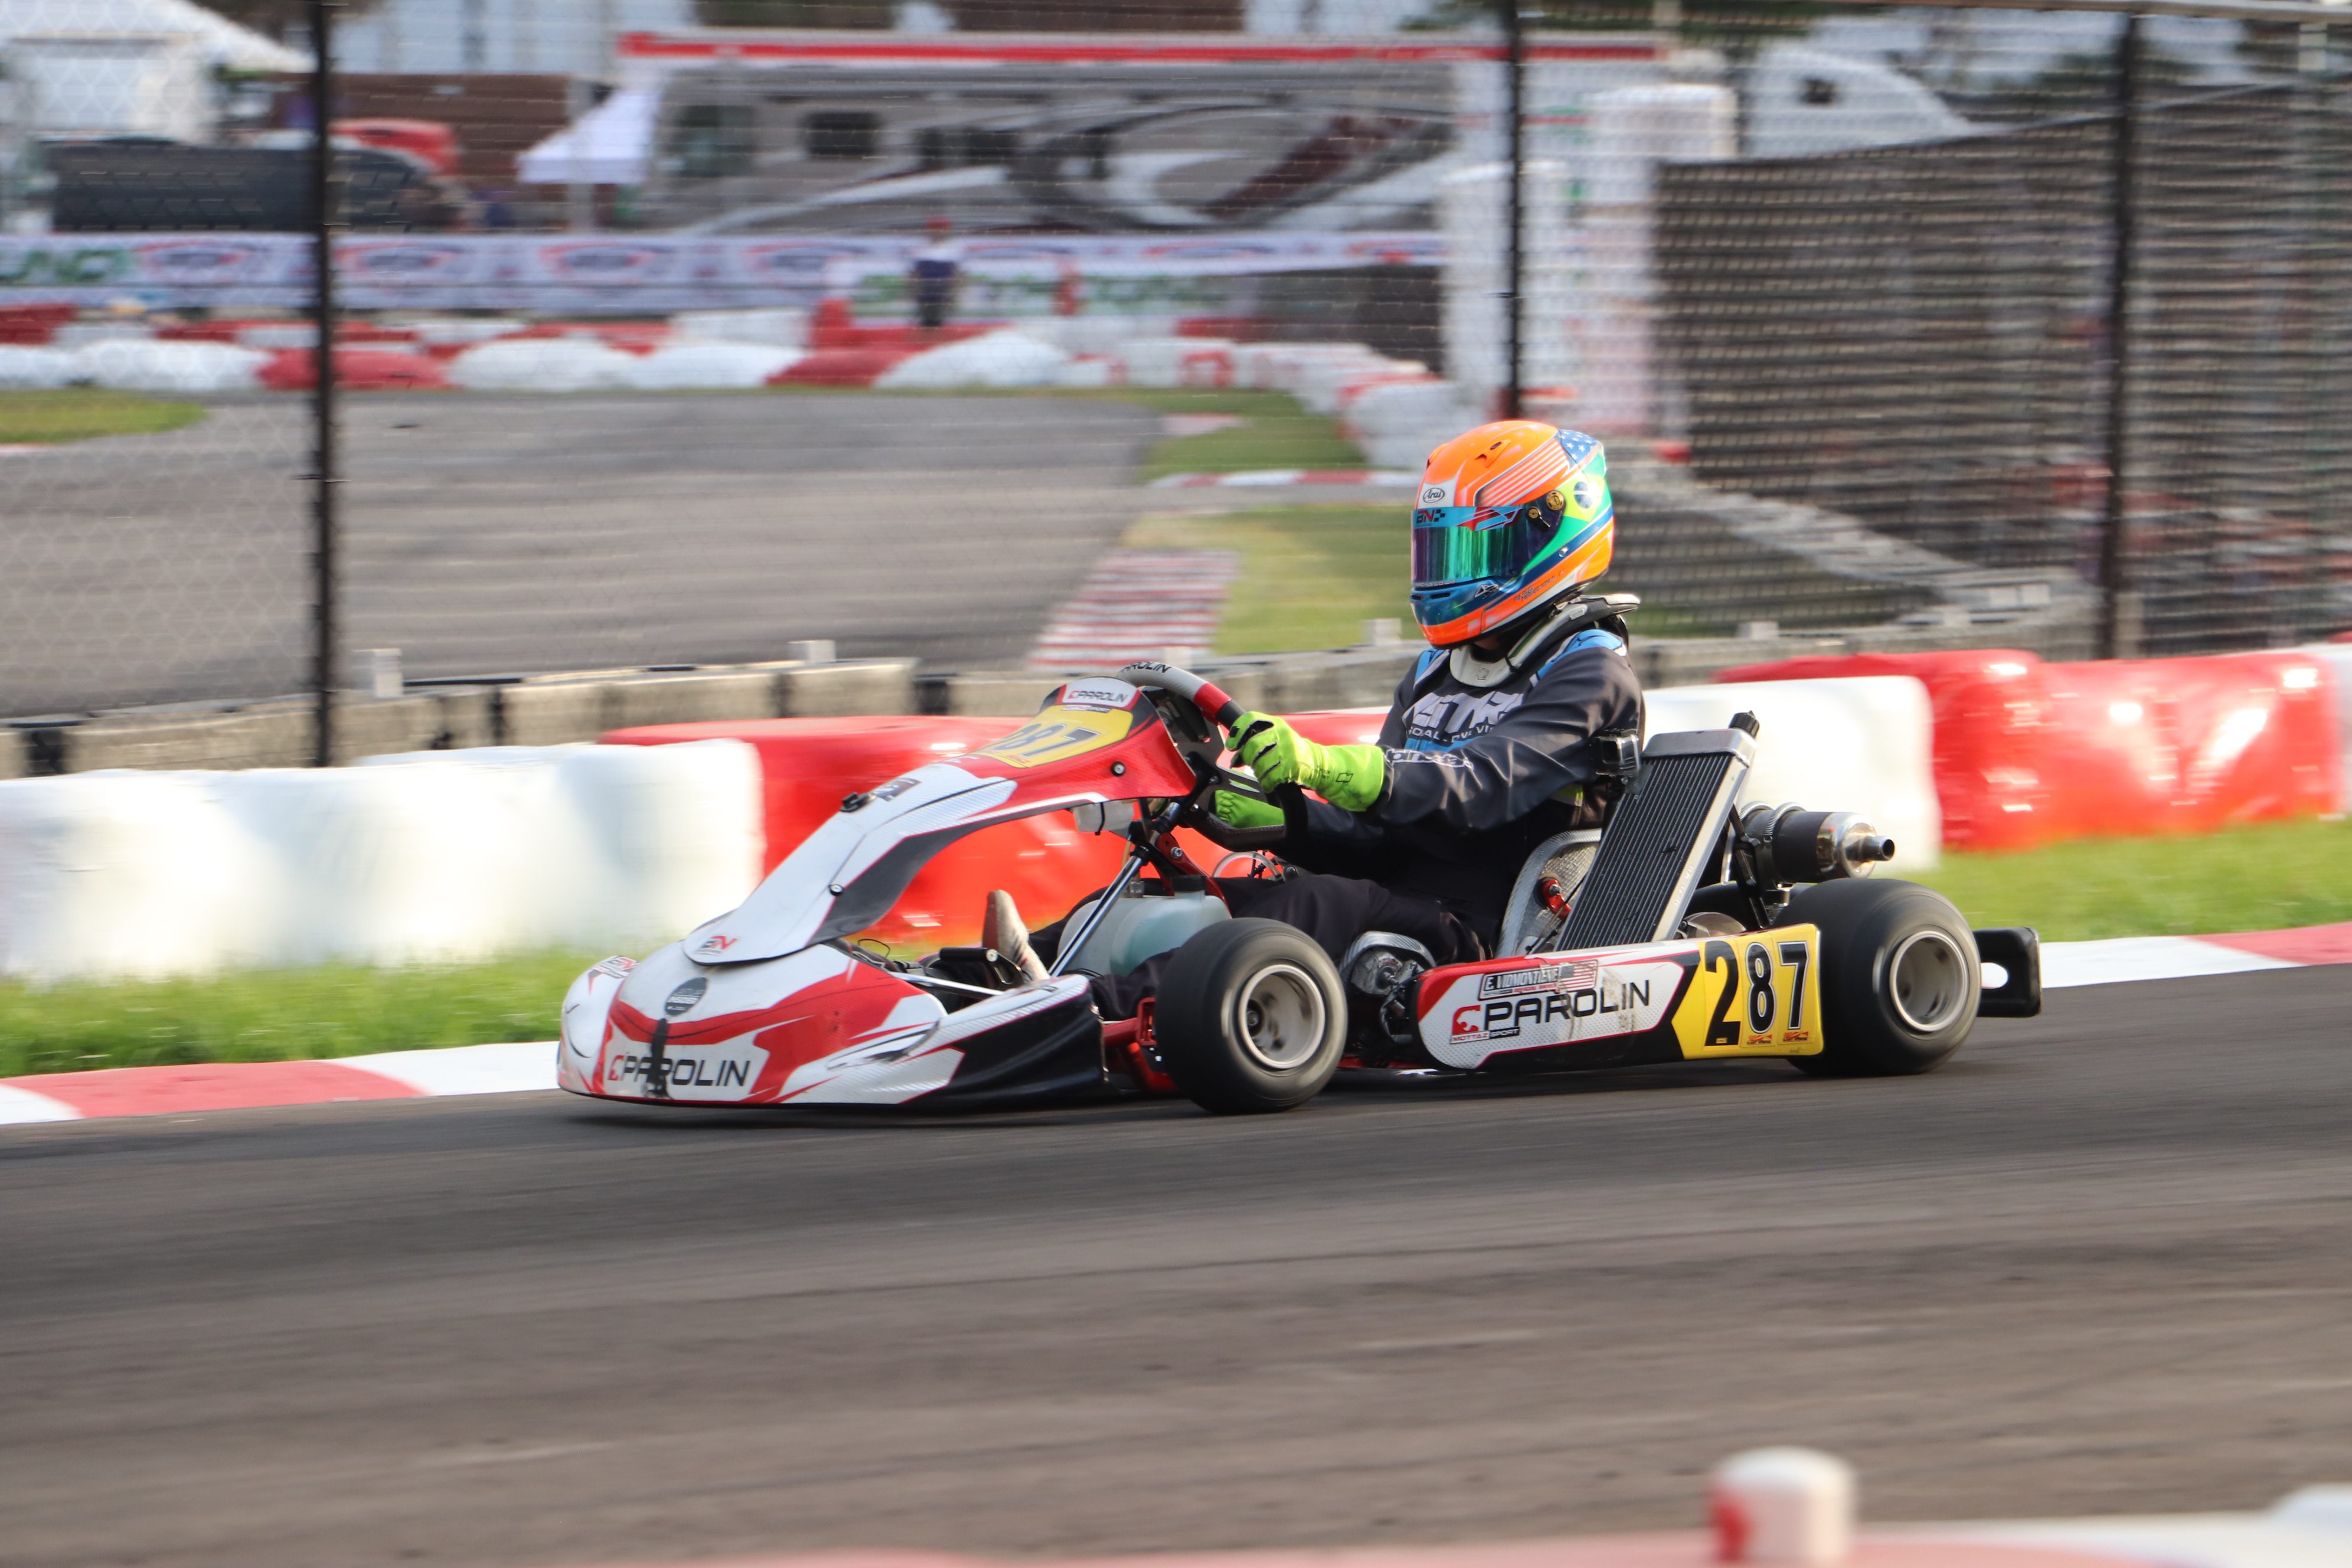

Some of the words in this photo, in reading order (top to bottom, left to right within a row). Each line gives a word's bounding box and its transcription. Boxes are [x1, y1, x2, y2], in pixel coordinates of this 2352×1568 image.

[1424, 489, 1442, 499] Arai
[1484, 979, 1651, 1030] PAROLIN
[1704, 940, 1811, 1047] 287
[1452, 1033, 1488, 1042] MOTTAZ
[1489, 1028, 1520, 1037] SPORT
